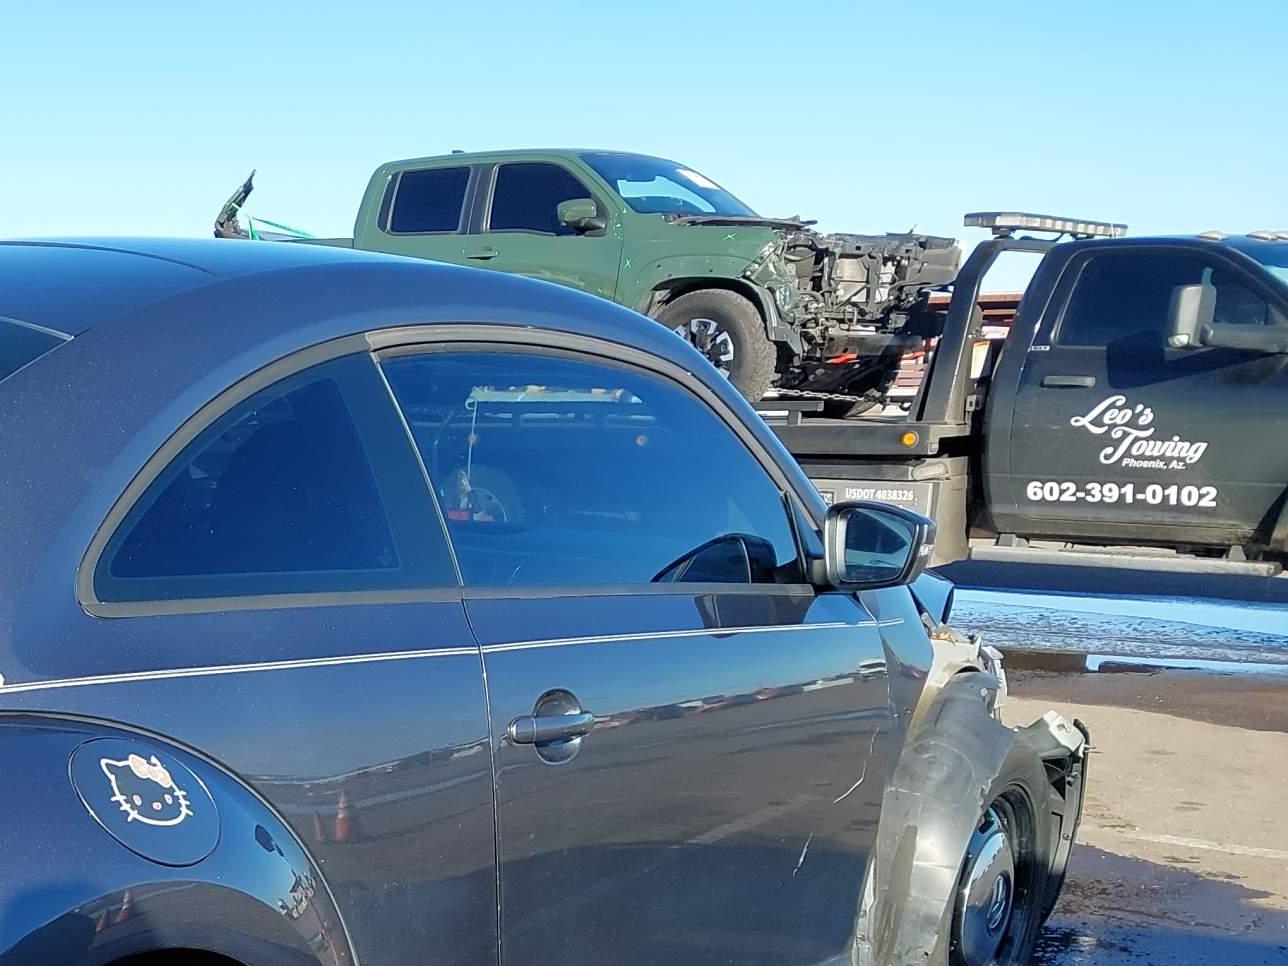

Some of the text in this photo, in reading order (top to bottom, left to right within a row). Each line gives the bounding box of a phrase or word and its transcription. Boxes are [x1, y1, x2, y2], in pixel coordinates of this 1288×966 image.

[1070, 395, 1154, 434] Leo's
[1099, 426, 1209, 464] Towing
[1121, 458, 1167, 470] Phoenix,
[845, 488, 875, 500] USDOT
[875, 489, 914, 500] 4038326
[1026, 481, 1218, 507] 602-391-0102
